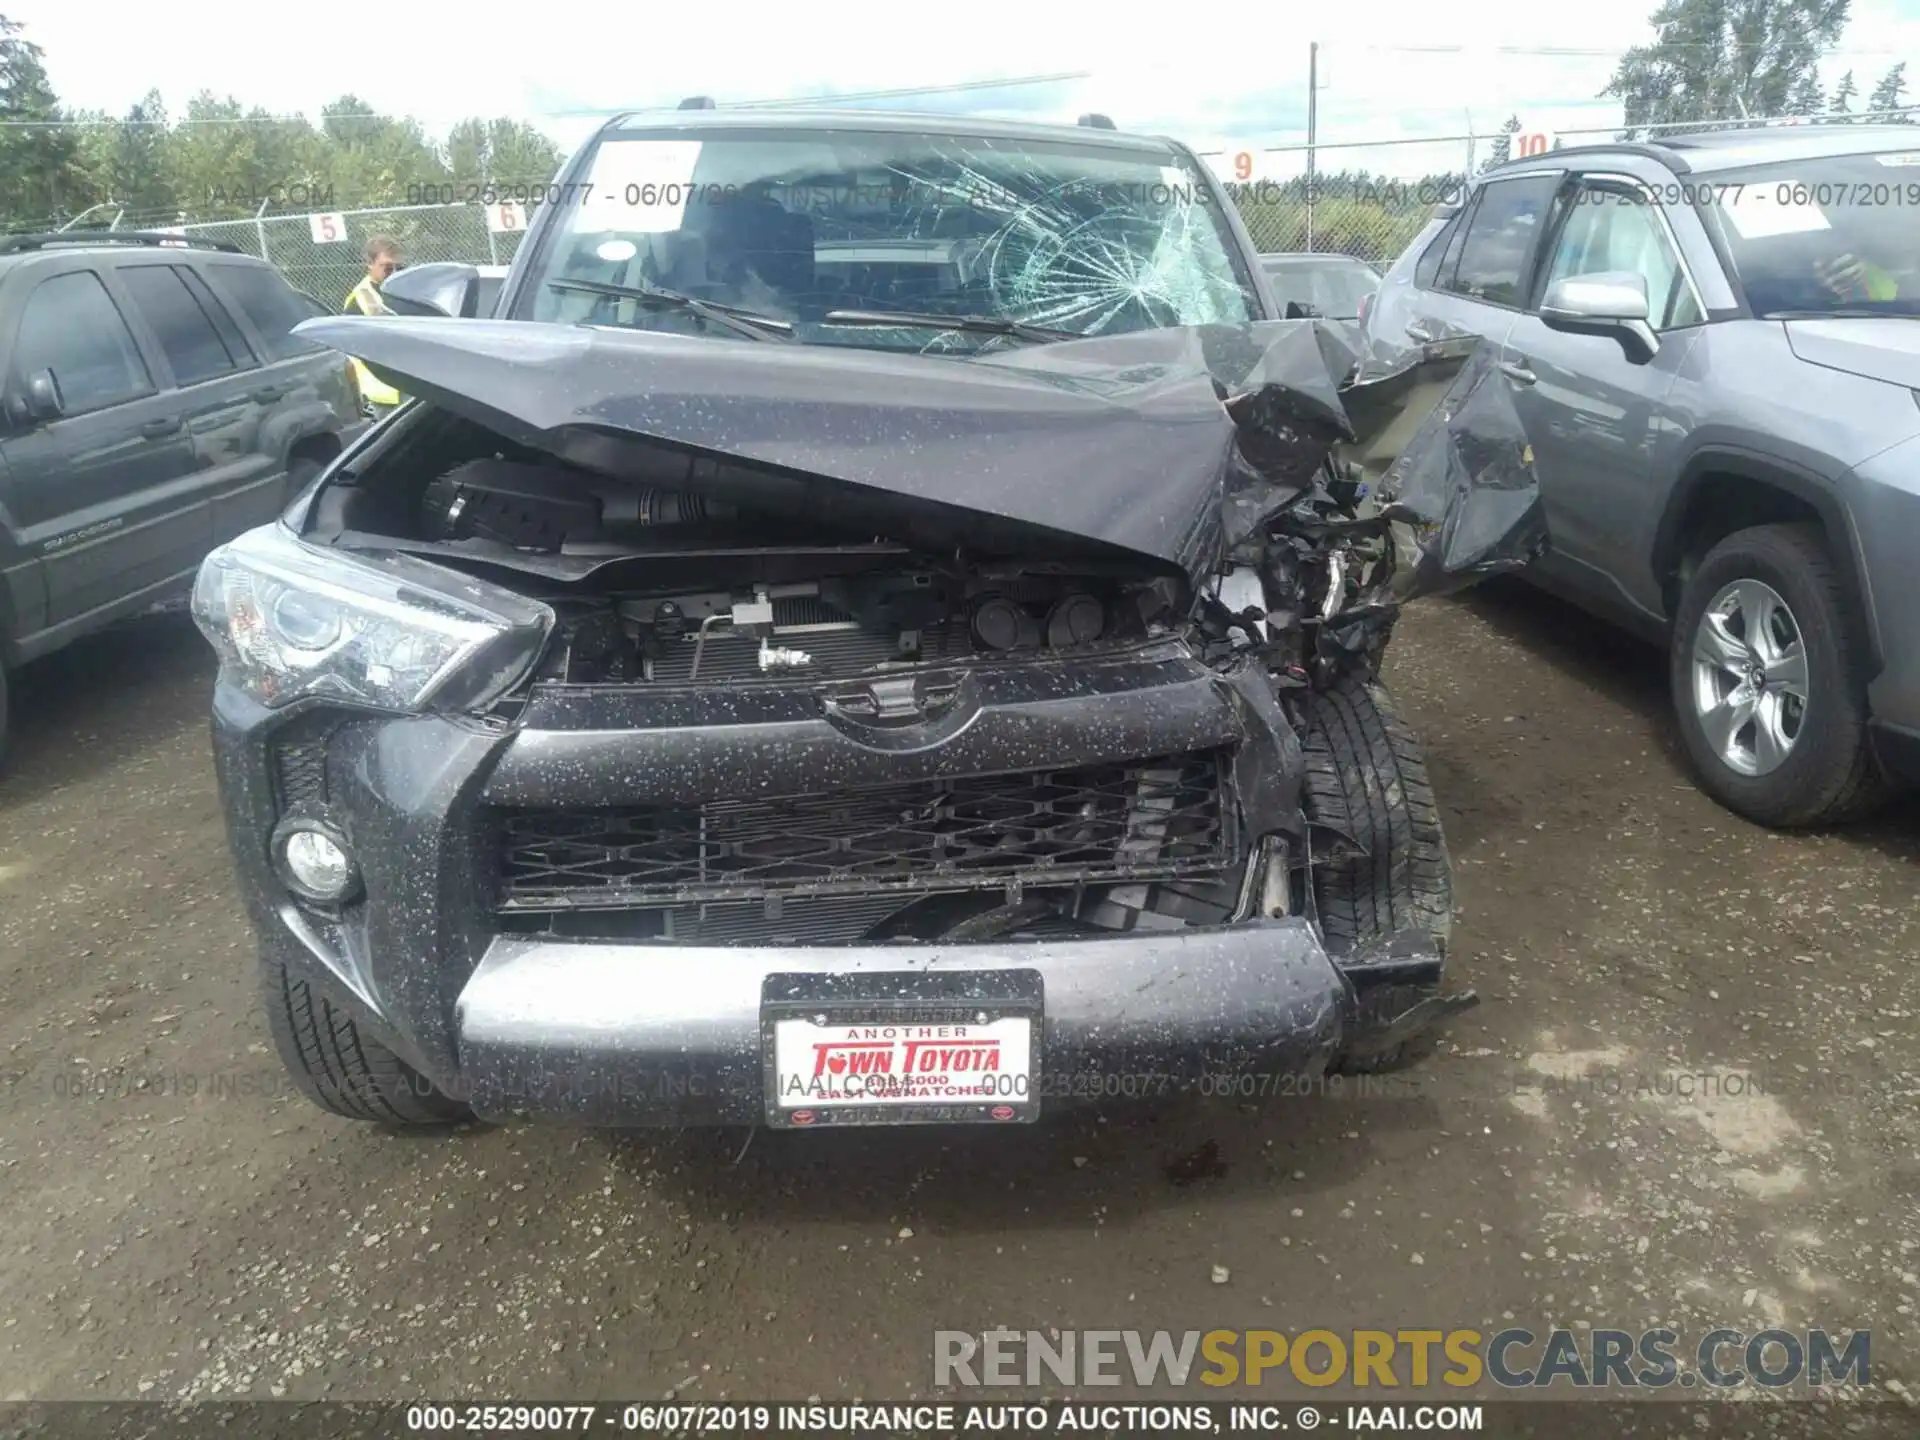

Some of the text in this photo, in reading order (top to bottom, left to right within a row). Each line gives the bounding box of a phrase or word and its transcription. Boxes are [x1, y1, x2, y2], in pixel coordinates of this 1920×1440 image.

[1516, 132, 1548, 159] 10
[1233, 150, 1254, 180] 9
[319, 216, 338, 241] 5
[499, 205, 517, 230] 6
[847, 1026, 968, 1040] ANOTHER
[902, 1039, 1001, 1073] TOYOTA
